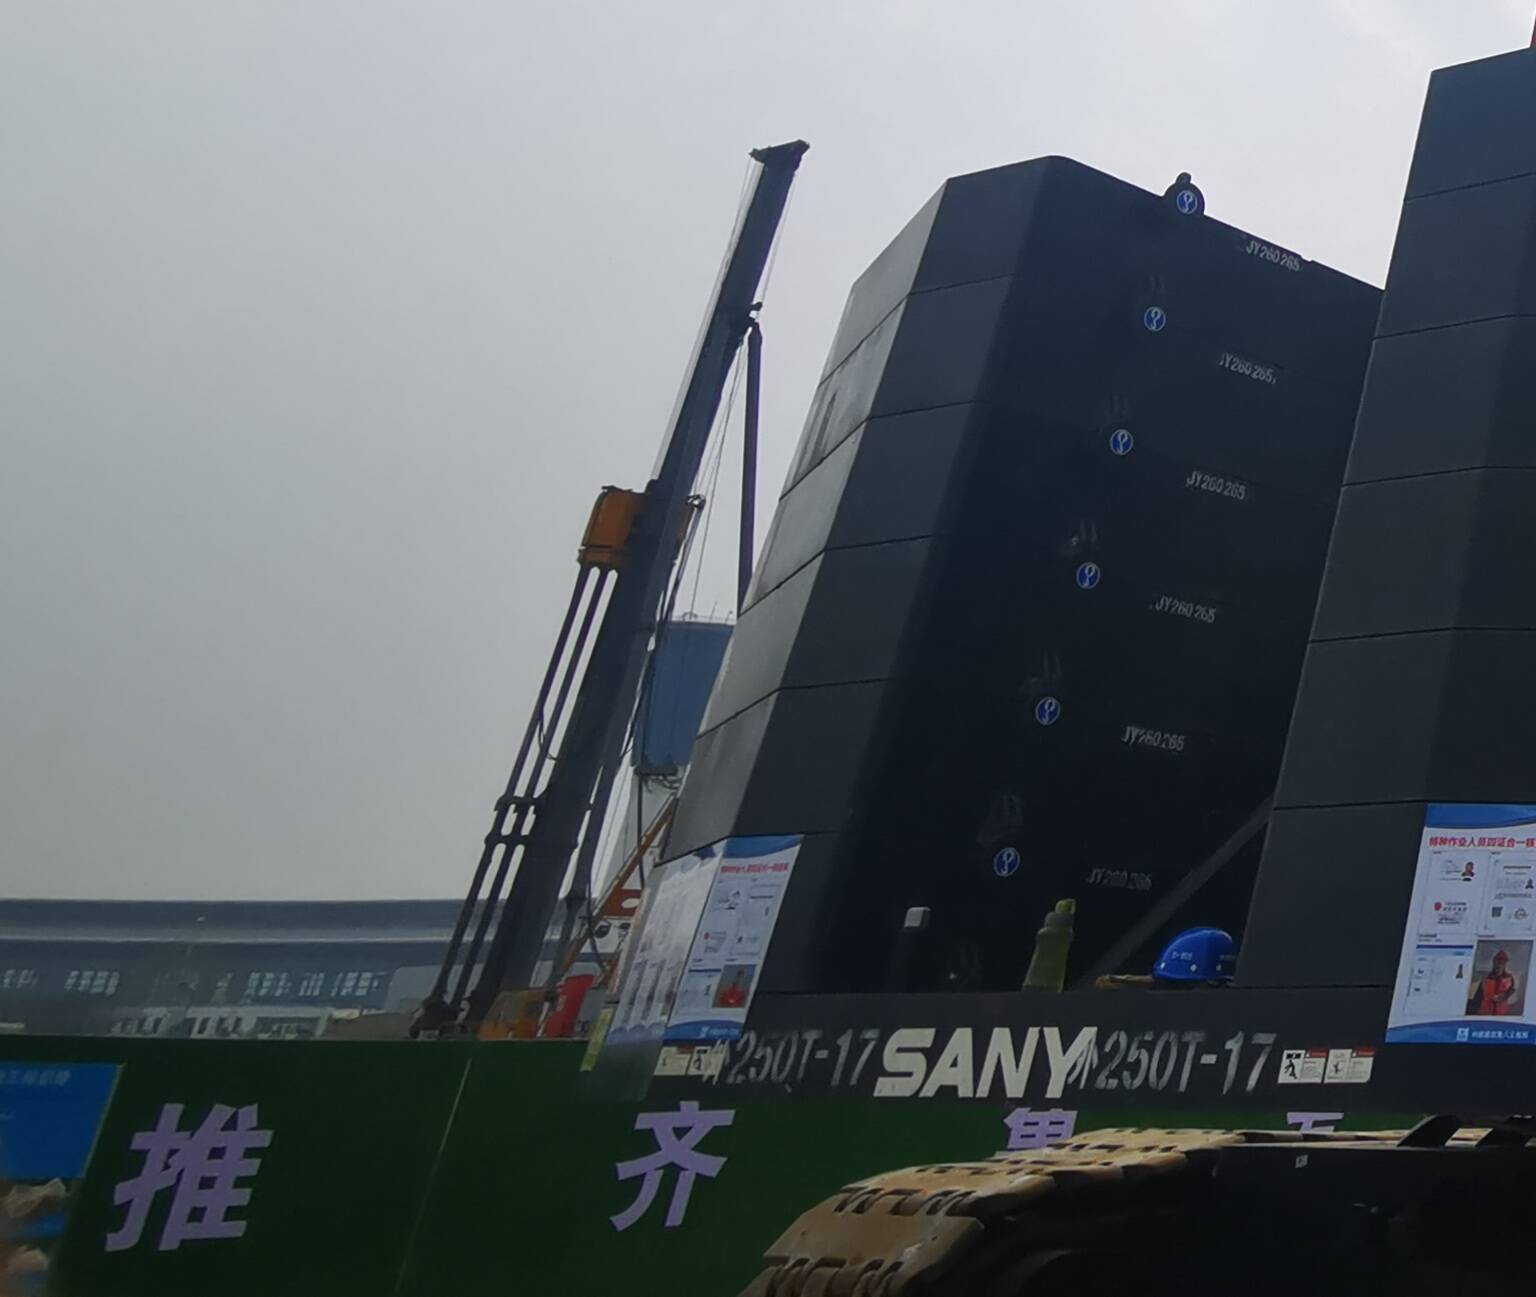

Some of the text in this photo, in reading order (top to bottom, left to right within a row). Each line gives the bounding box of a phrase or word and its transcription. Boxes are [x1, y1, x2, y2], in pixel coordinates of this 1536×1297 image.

[873, 1027, 1098, 1098] SANY
[105, 1101, 736, 1251] 推 齐
